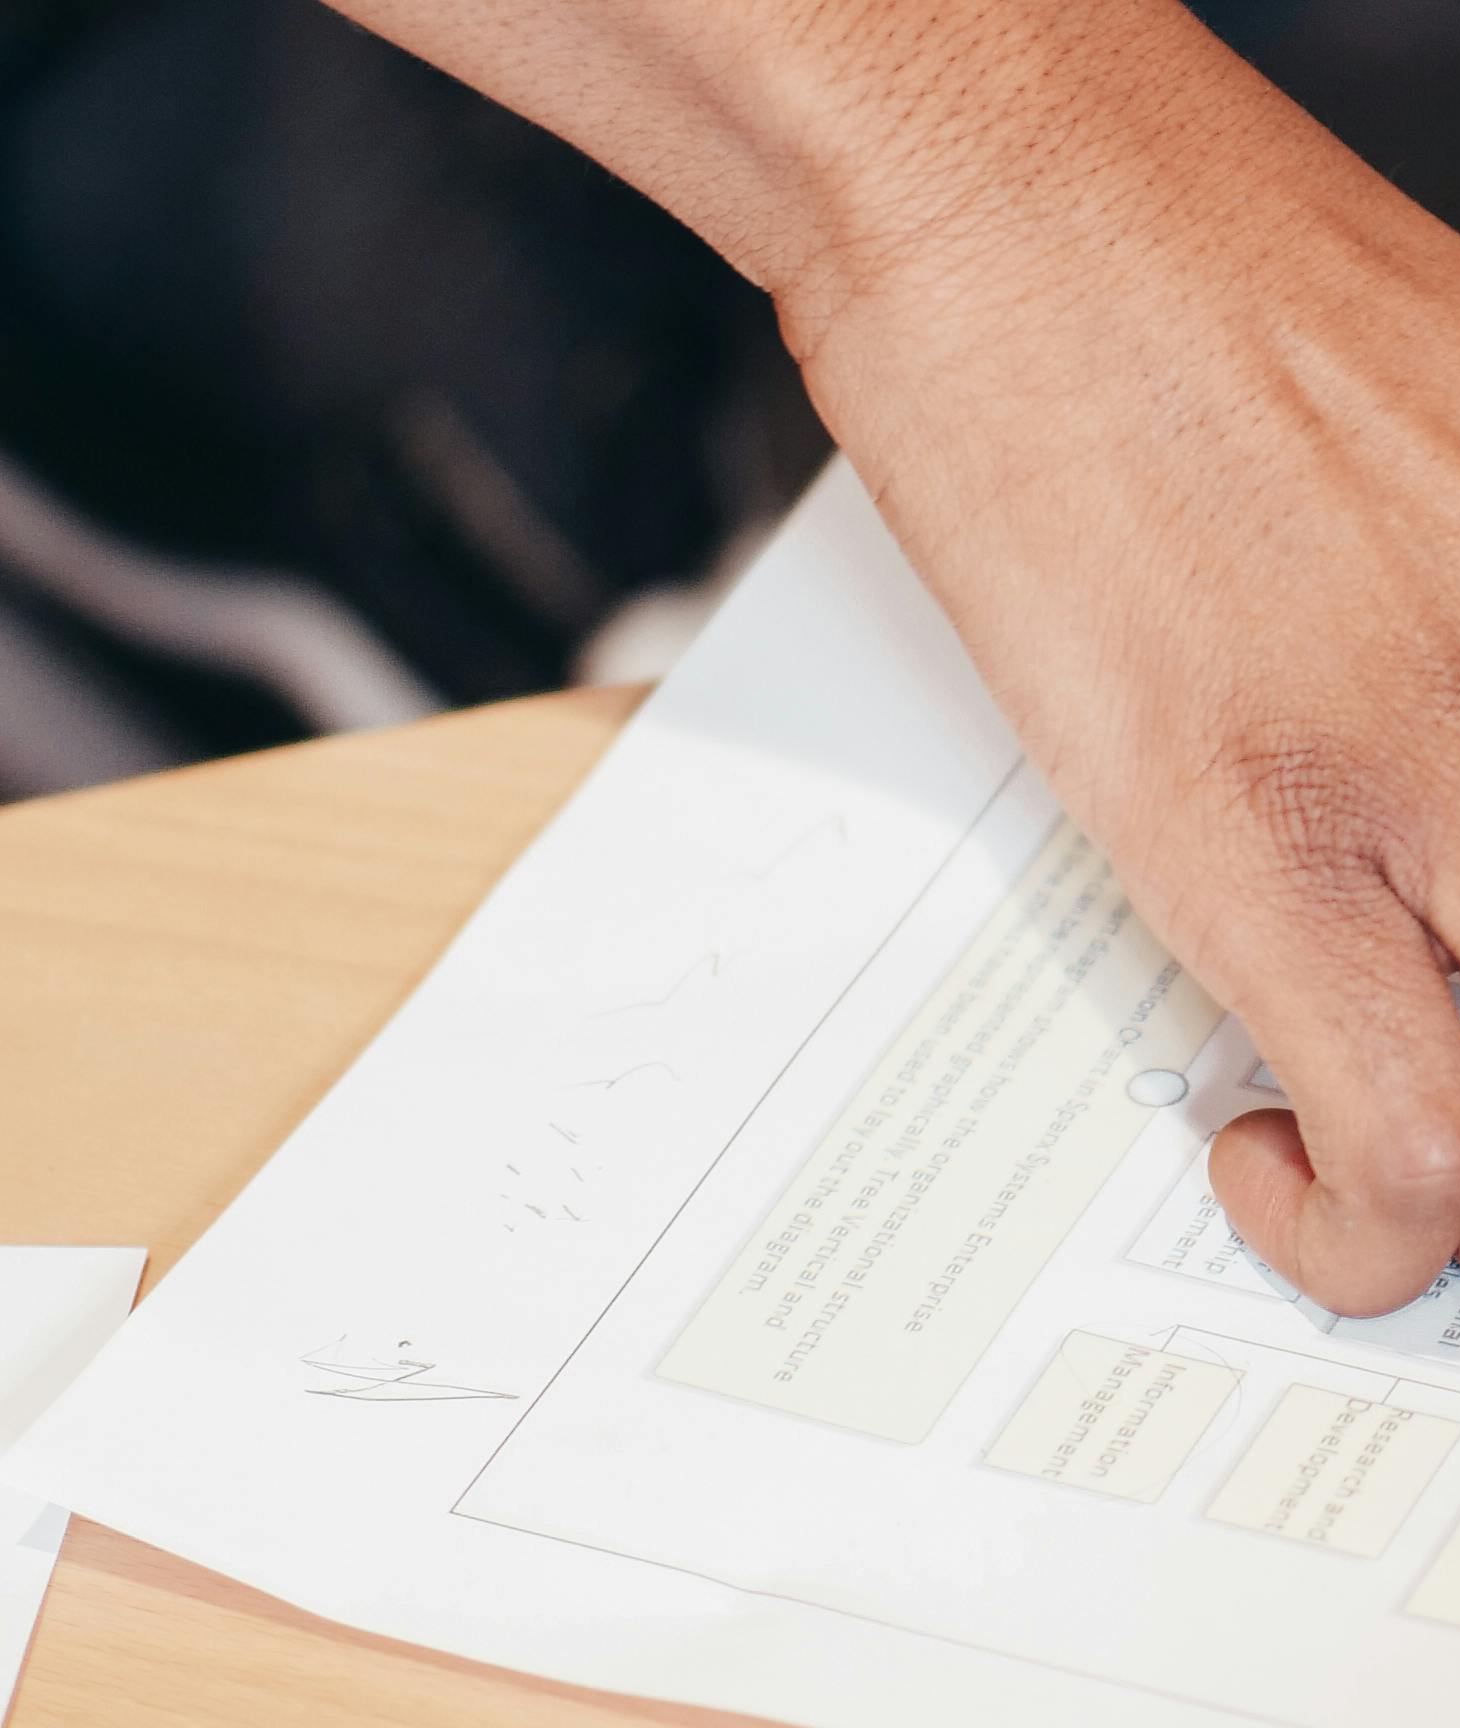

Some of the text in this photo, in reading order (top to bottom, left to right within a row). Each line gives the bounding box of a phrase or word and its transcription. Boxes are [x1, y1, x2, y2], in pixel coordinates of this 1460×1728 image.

[893, 1037, 944, 1084] used
[876, 1084, 908, 1107] to
[967, 1074, 1014, 1115] how
[1071, 1078, 1106, 1100] in
[850, 1107, 893, 1139] lay
[941, 1116, 983, 1151] the
[1032, 1098, 1091, 1152] Sparx
[828, 1139, 867, 1173] out
[801, 1174, 843, 1211] the
[848, 1164, 900, 1211] Tree
[974, 1152, 1051, 1230] Systems
[838, 1151, 953, 1290] organizational
[735, 1211, 817, 1298] diagram.
[791, 1213, 866, 1290] Vertical
[899, 1231, 994, 1335] Enterprise
[761, 1290, 809, 1332] and
[770, 1290, 854, 1384] structure
[1039, 1345, 1151, 1480] Management
[1087, 1361, 1188, 1481] Information
[1262, 1397, 1371, 1534] Development
[1303, 1405, 1414, 1544] Research and
